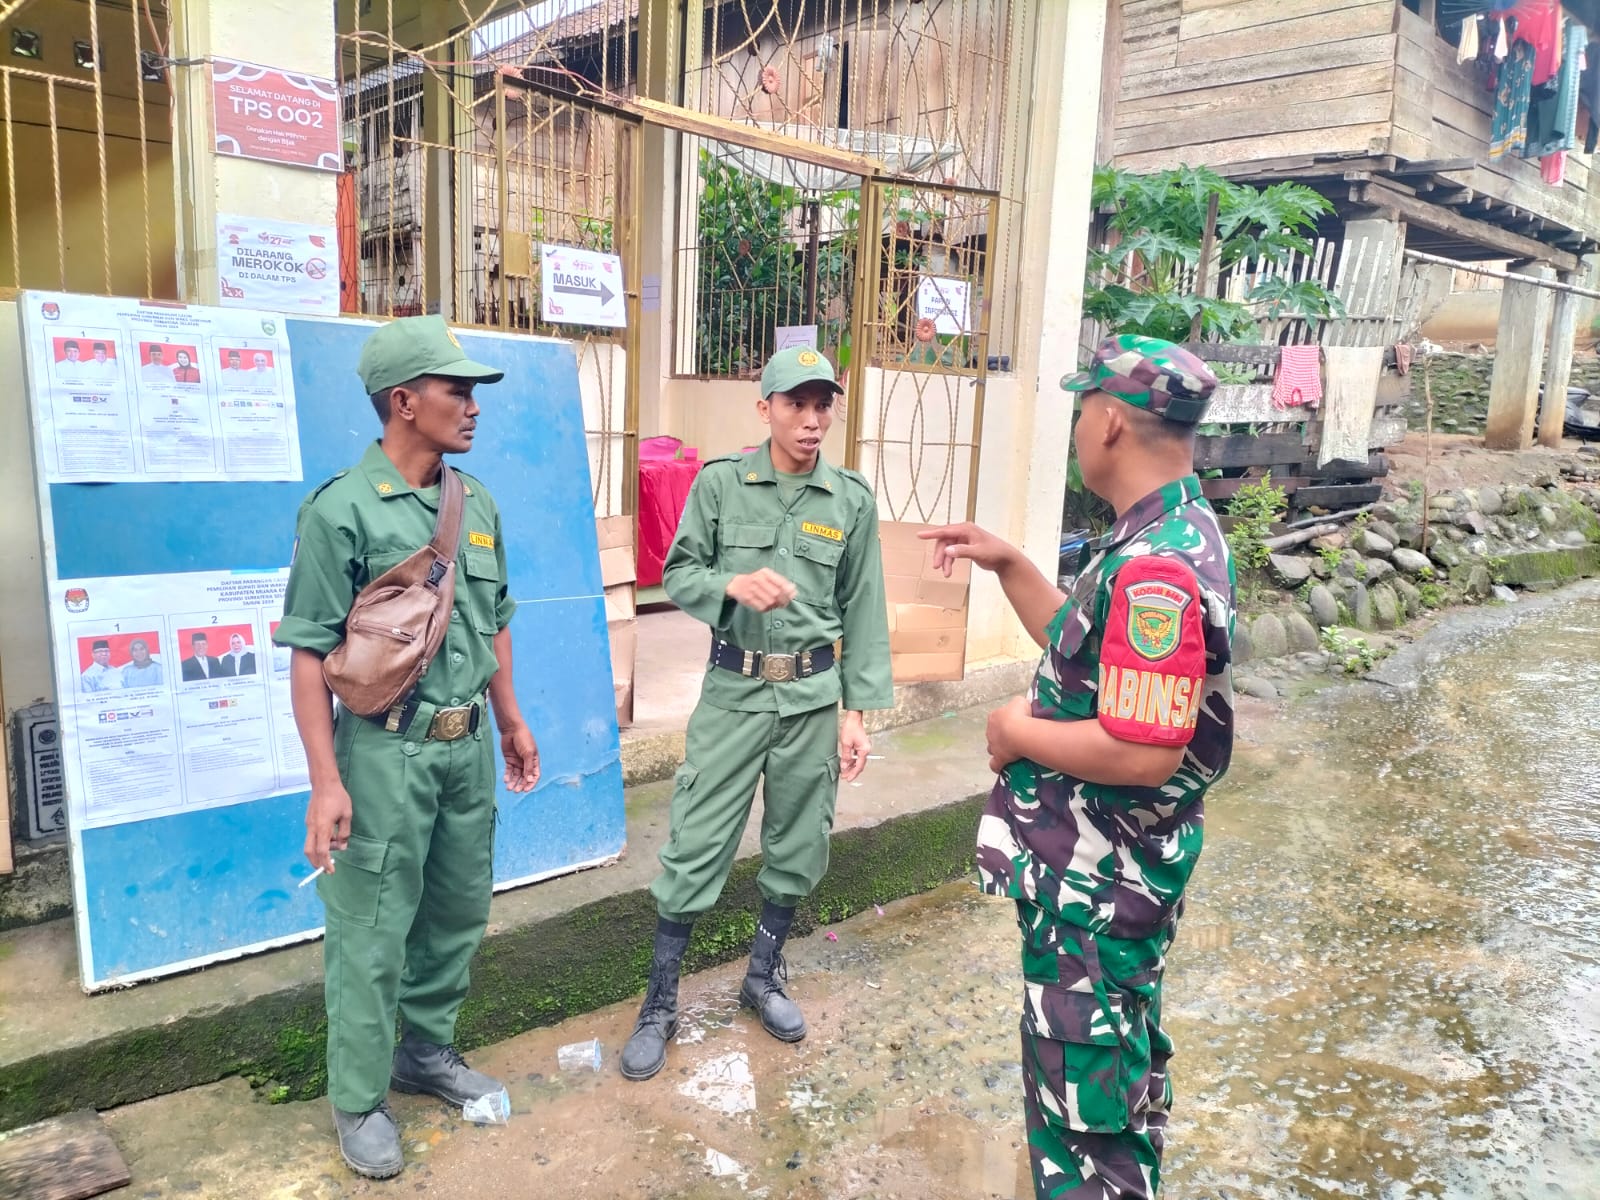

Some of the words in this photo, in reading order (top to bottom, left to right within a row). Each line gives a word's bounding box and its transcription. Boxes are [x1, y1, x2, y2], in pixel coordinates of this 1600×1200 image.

[229, 84, 272, 98] SELAMAT
[274, 92, 311, 106] DATANG
[312, 100, 320, 108] DI
[228, 96, 272, 119] TPS
[236, 248, 293, 260] DILARANG
[232, 256, 304, 274] MEROKOK
[250, 272, 280, 282] DALAM
[553, 272, 596, 288] MASUK
[931, 296, 950, 304] PAPN
[804, 524, 840, 539] LINMAS
[470, 534, 493, 546] LINMA
[211, 616, 218, 624] 2
[114, 624, 120, 632] 1
